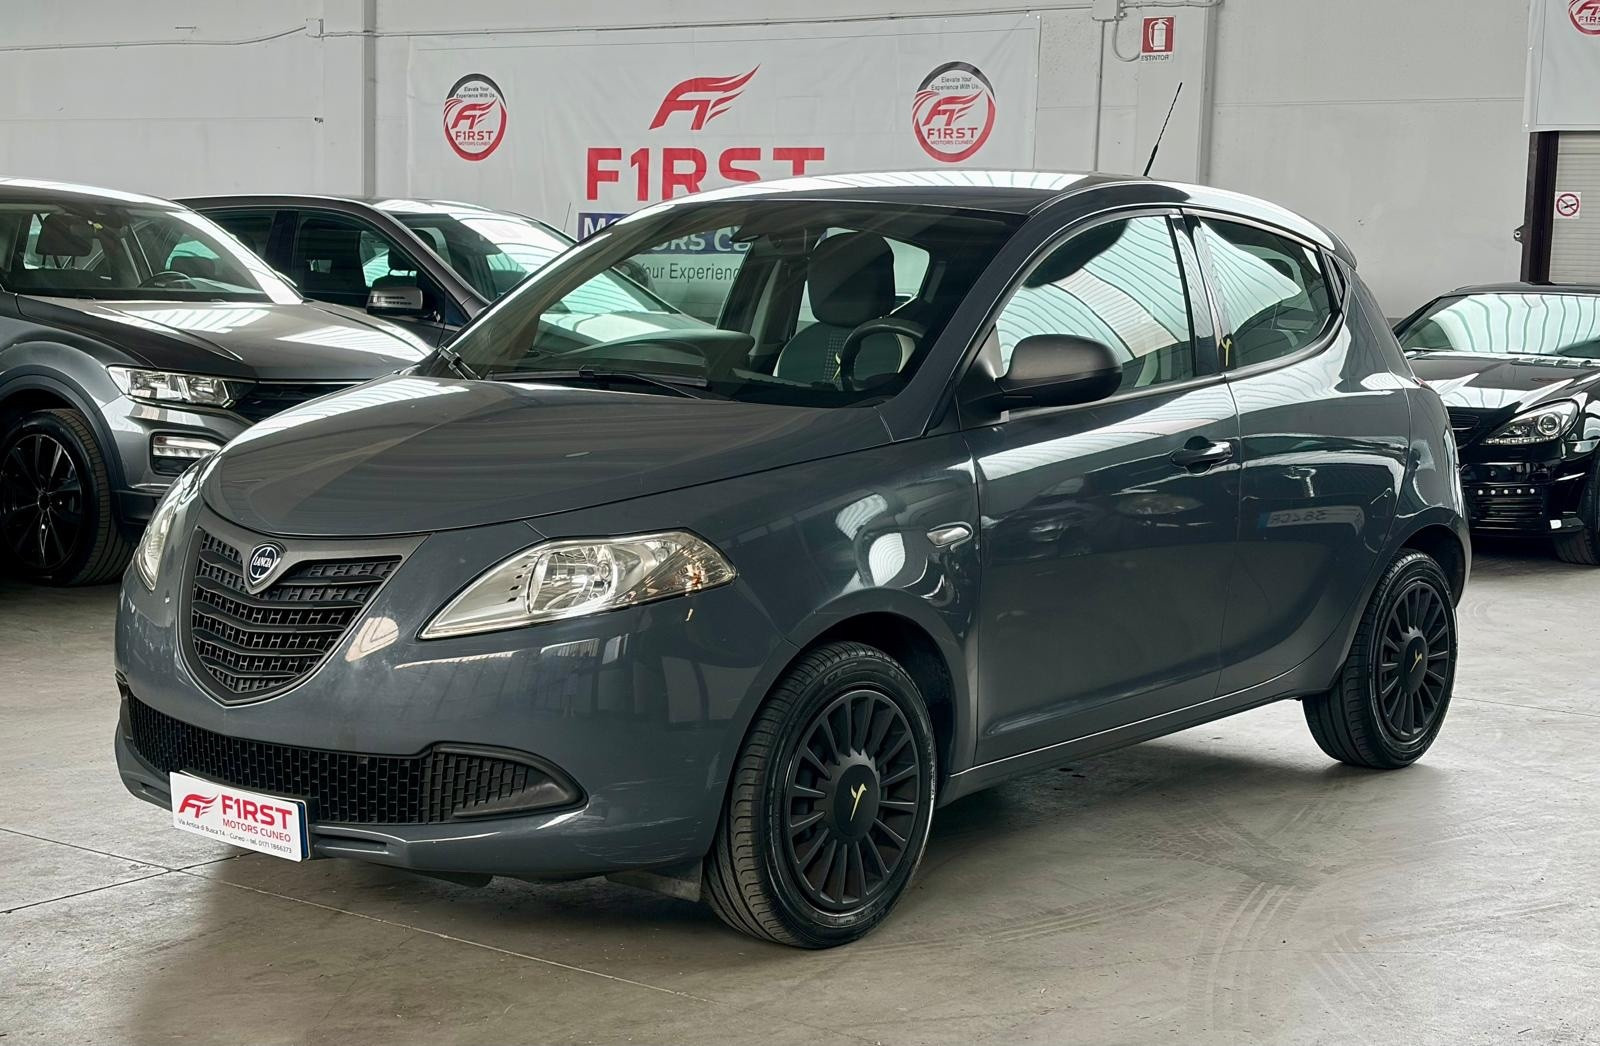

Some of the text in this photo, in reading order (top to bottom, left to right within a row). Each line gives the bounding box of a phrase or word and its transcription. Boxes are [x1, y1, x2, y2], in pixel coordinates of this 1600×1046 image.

[455, 131, 494, 141] F1RST
[927, 127, 978, 139] F1RST
[587, 147, 825, 201] F1RST
[221, 794, 292, 830] F1RST
[222, 818, 291, 843] MOTORS CUNEO
